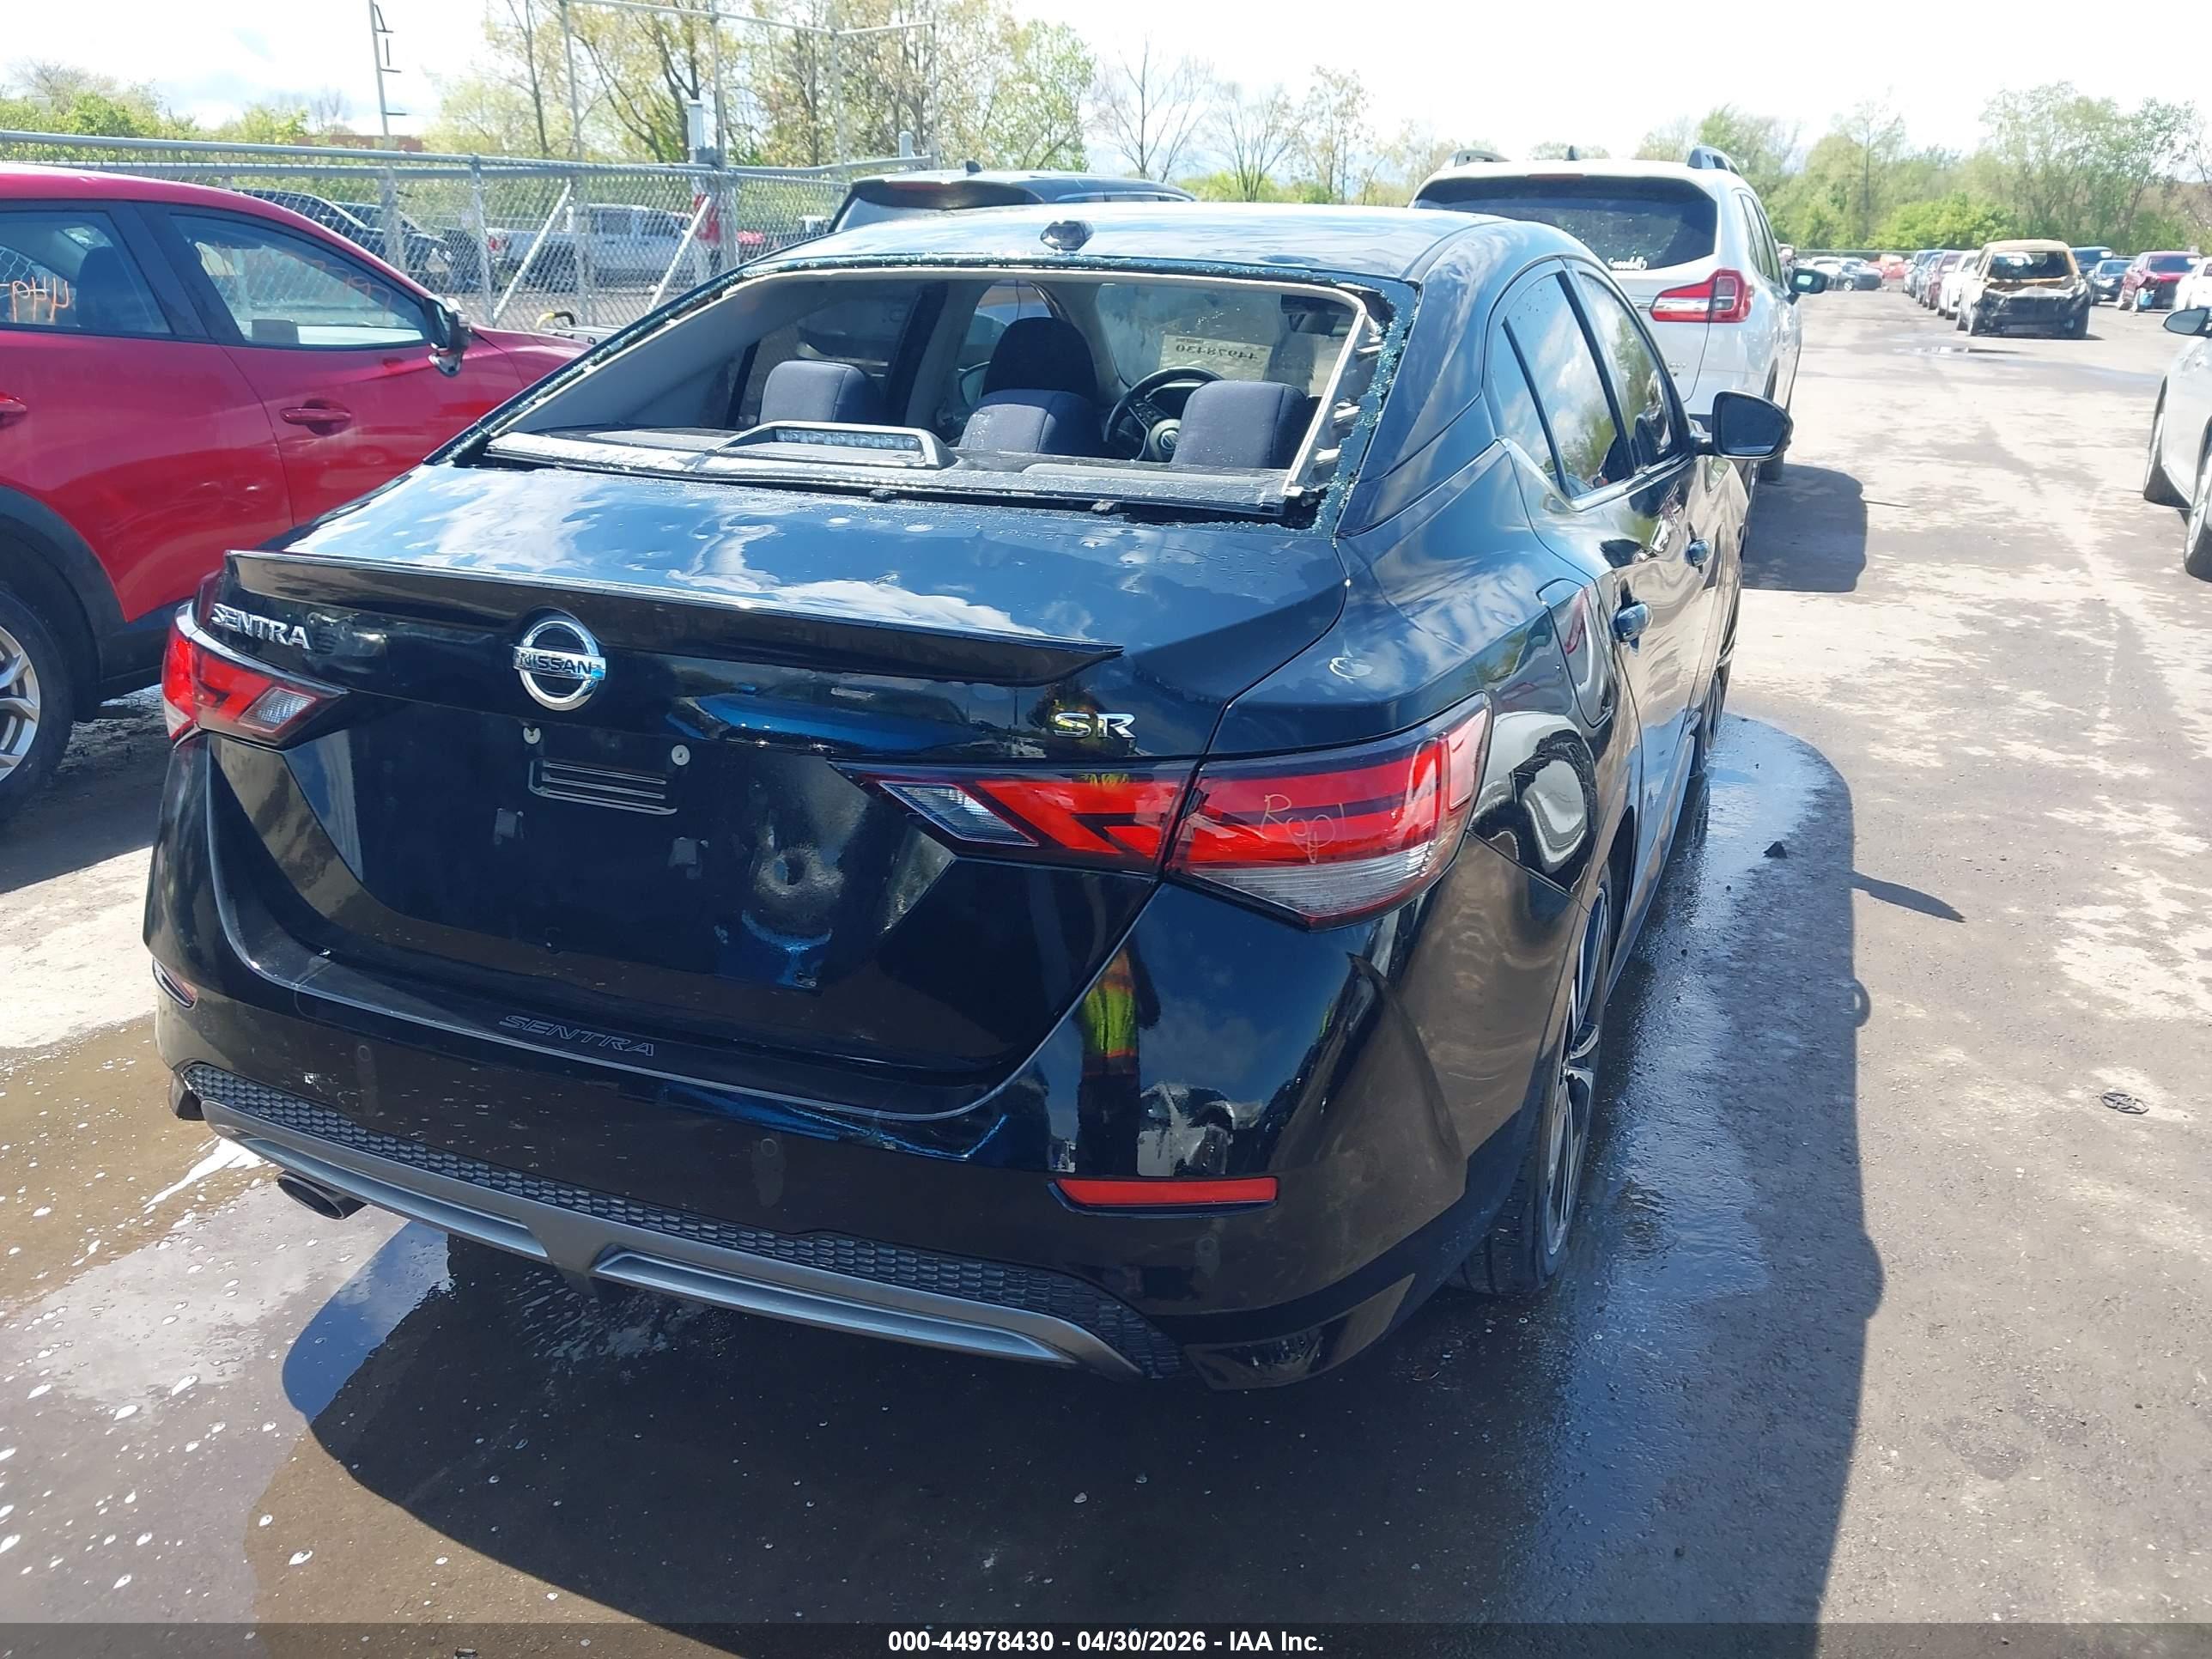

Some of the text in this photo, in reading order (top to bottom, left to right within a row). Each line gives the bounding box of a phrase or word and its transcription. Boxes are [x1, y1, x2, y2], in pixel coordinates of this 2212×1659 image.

[211, 603, 311, 650] SENTRA
[516, 652, 592, 674] NISSAN
[1053, 712, 1136, 738] SR
[499, 1015, 654, 1056] SENTRA
